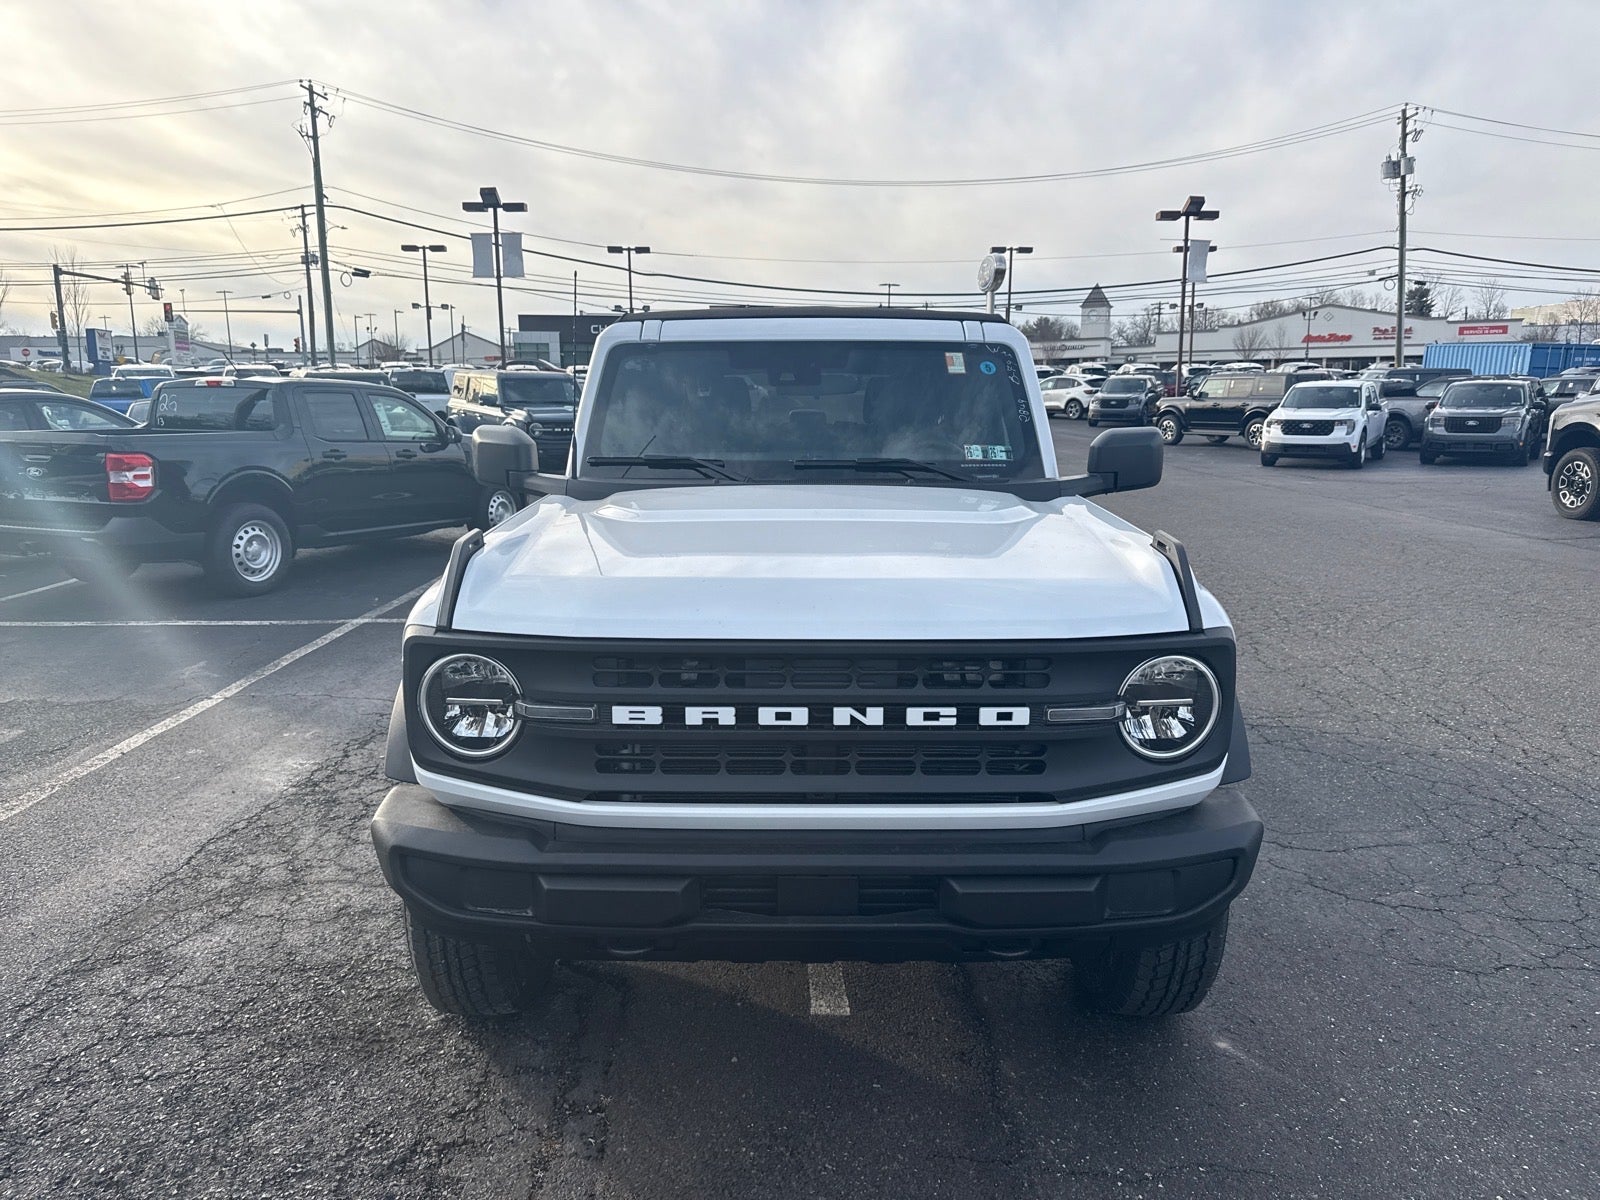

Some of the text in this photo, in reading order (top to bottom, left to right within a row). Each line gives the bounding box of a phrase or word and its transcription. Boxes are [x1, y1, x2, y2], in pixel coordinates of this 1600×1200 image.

[1301, 332, 1353, 343] AutoZone
[985, 363, 992, 373] 5
[157, 417, 165, 426] 13
[612, 705, 1030, 726] BRONCO
